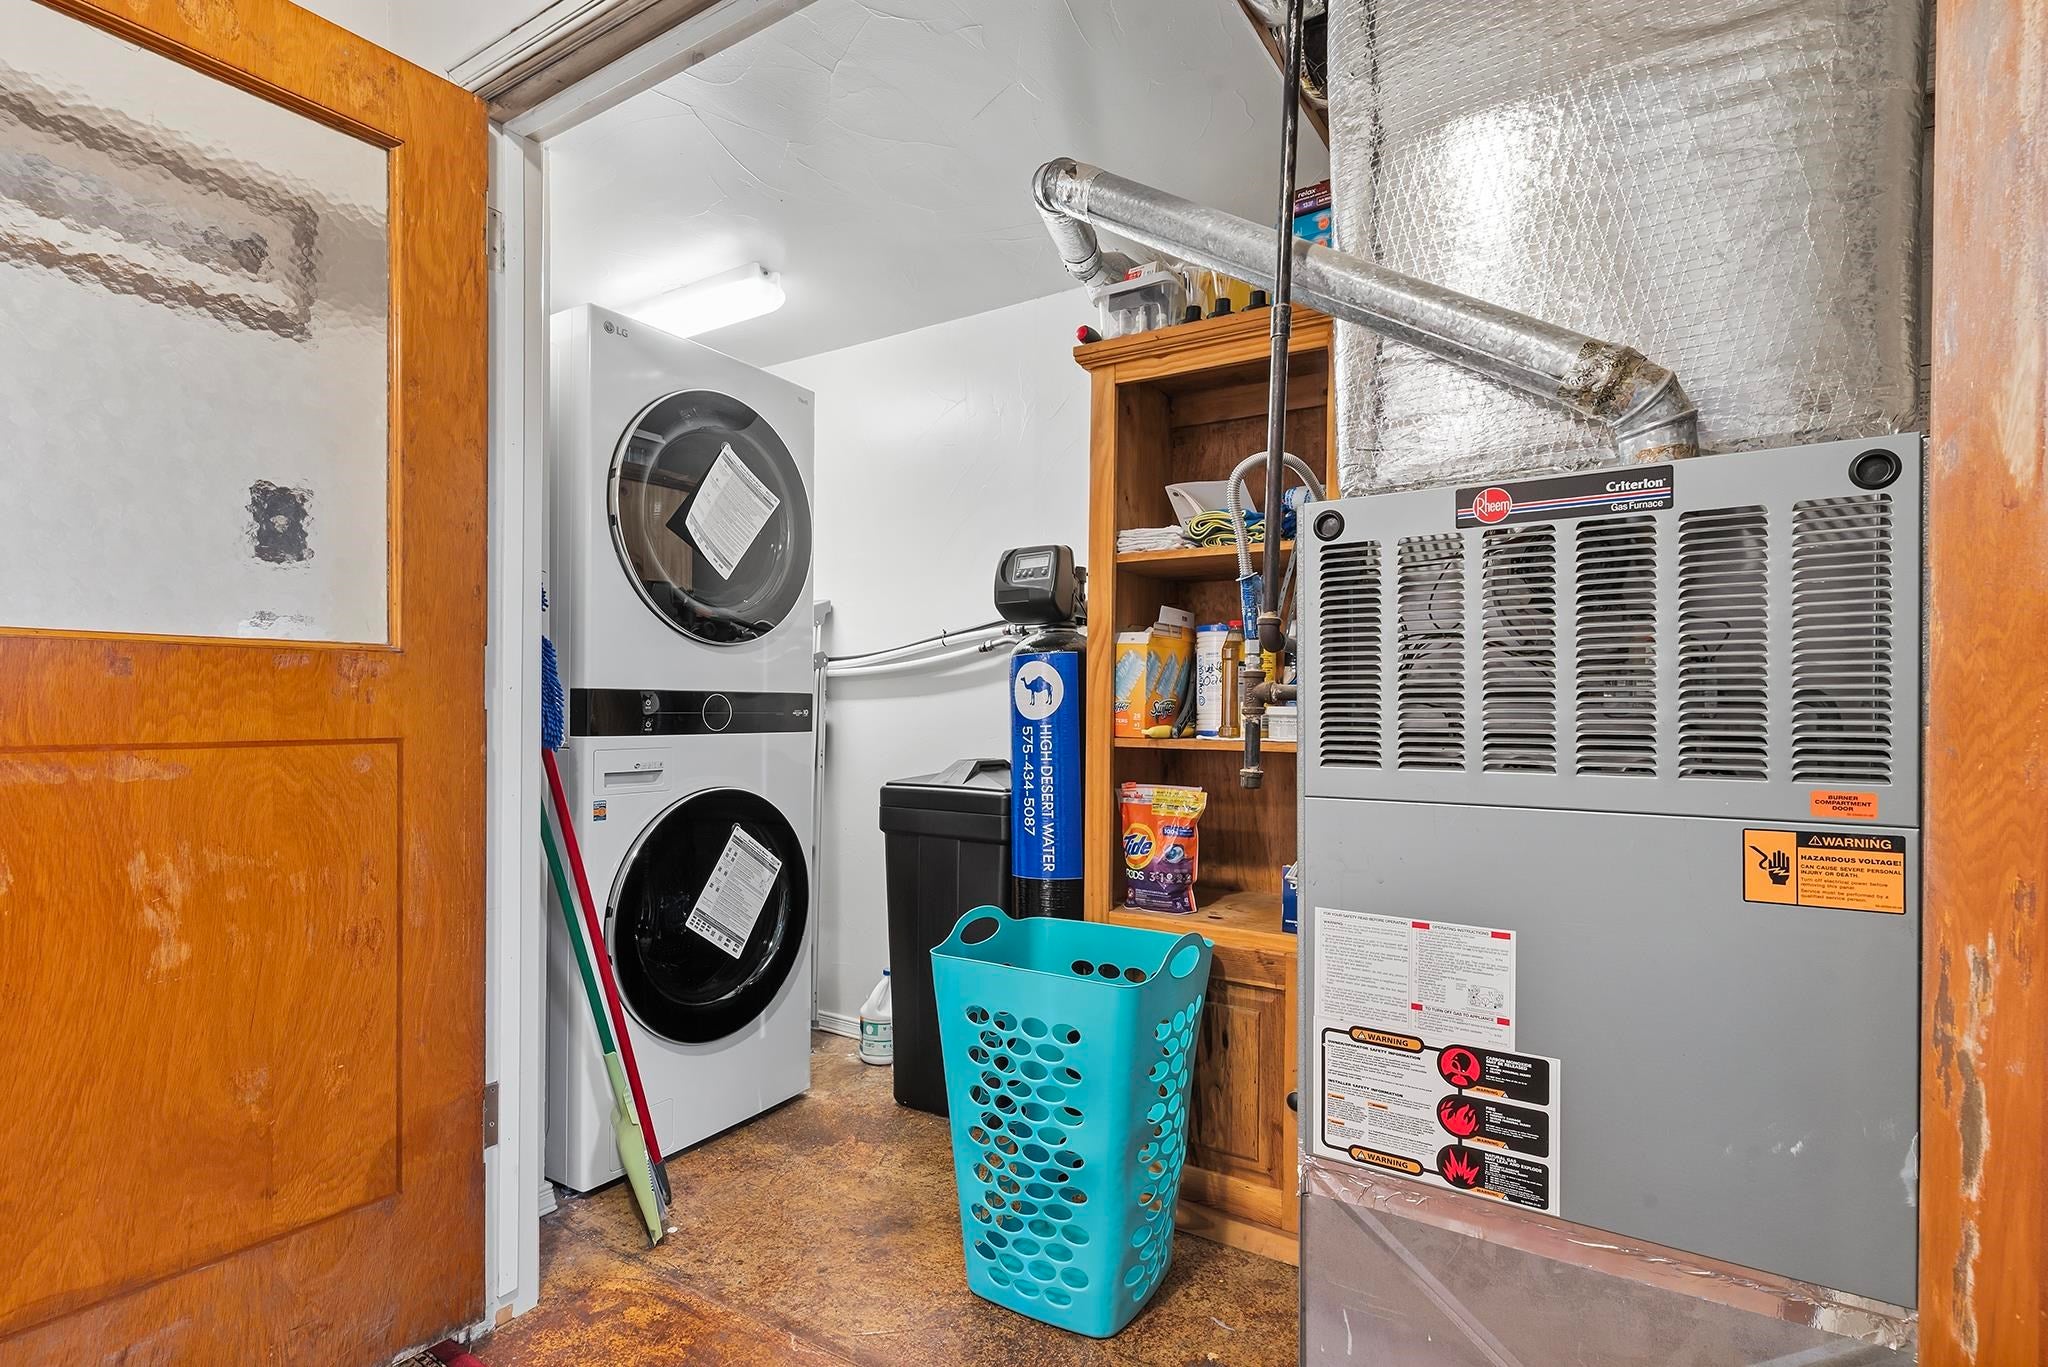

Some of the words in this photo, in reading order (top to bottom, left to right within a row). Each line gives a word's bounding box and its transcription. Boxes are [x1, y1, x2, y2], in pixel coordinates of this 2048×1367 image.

[1606, 478, 1664, 492] Criterion
[1476, 491, 1510, 517] Rheem
[1611, 503, 1628, 512] Gas
[1629, 500, 1663, 511] Furnace
[1040, 725, 1052, 760] HIGH
[1022, 726, 1036, 836] 575-434-5087
[1040, 766, 1054, 818] DESERT
[1815, 799, 1872, 807] COMPARTMENT
[1042, 822, 1055, 872] WATER
[1123, 834, 1152, 857] Tide
[1822, 836, 1892, 849] WARNING
[1801, 855, 1856, 863] HAZARDOUS
[1859, 858, 1902, 866] VOLTAGE!
[1367, 1033, 1408, 1047] WARNING
[1367, 1153, 1408, 1169] WARNING
